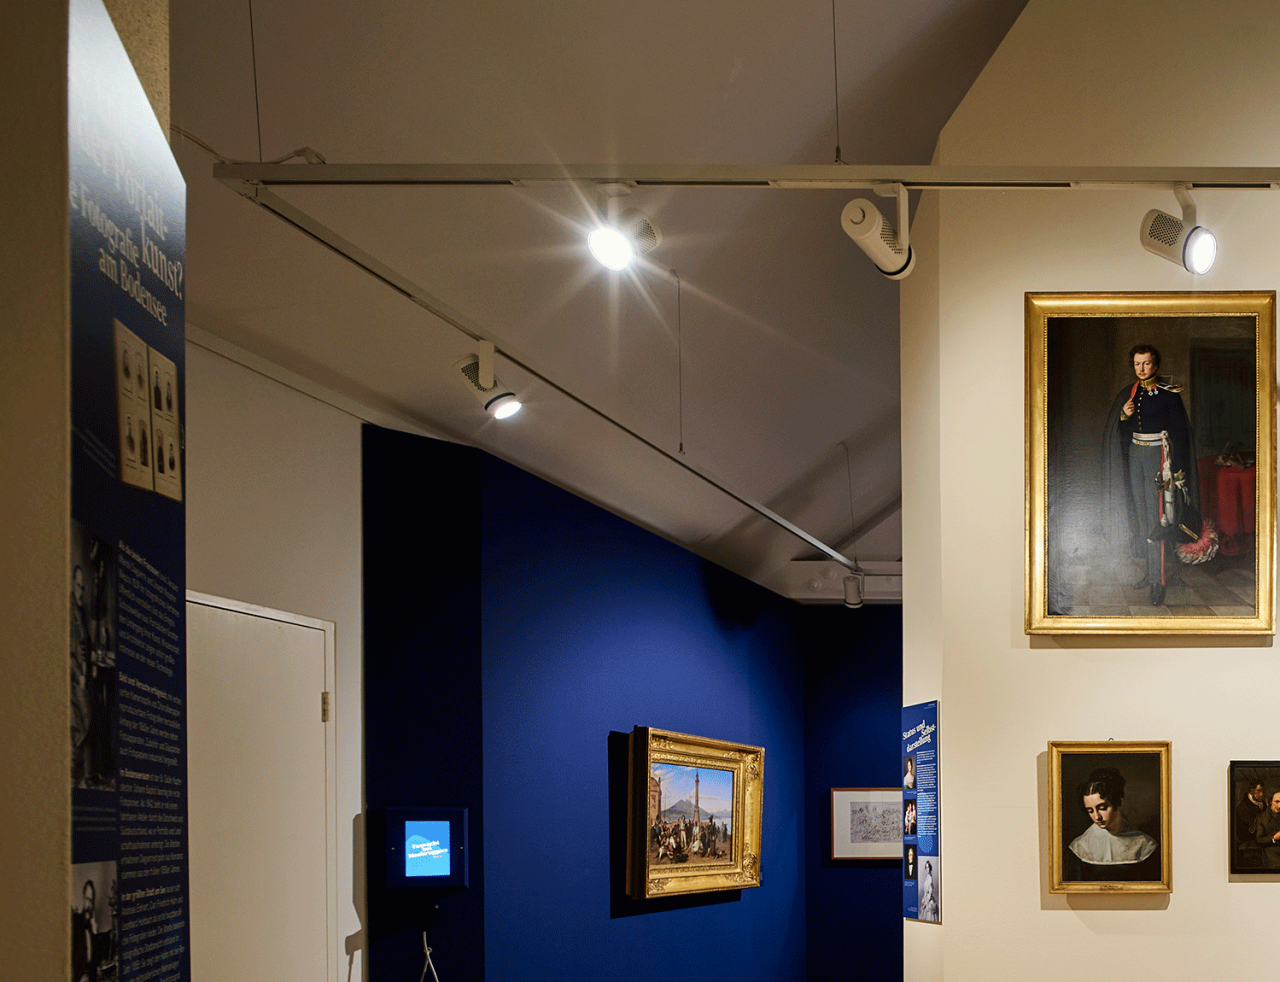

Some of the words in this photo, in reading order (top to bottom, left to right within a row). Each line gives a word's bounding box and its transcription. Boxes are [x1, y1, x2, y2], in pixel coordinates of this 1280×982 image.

[81, 183, 140, 269] Fotografie
[140, 214, 184, 301] kunst?
[98, 247, 118, 285] am
[120, 258, 168, 327] Bodensee
[916, 719, 926, 732] und
